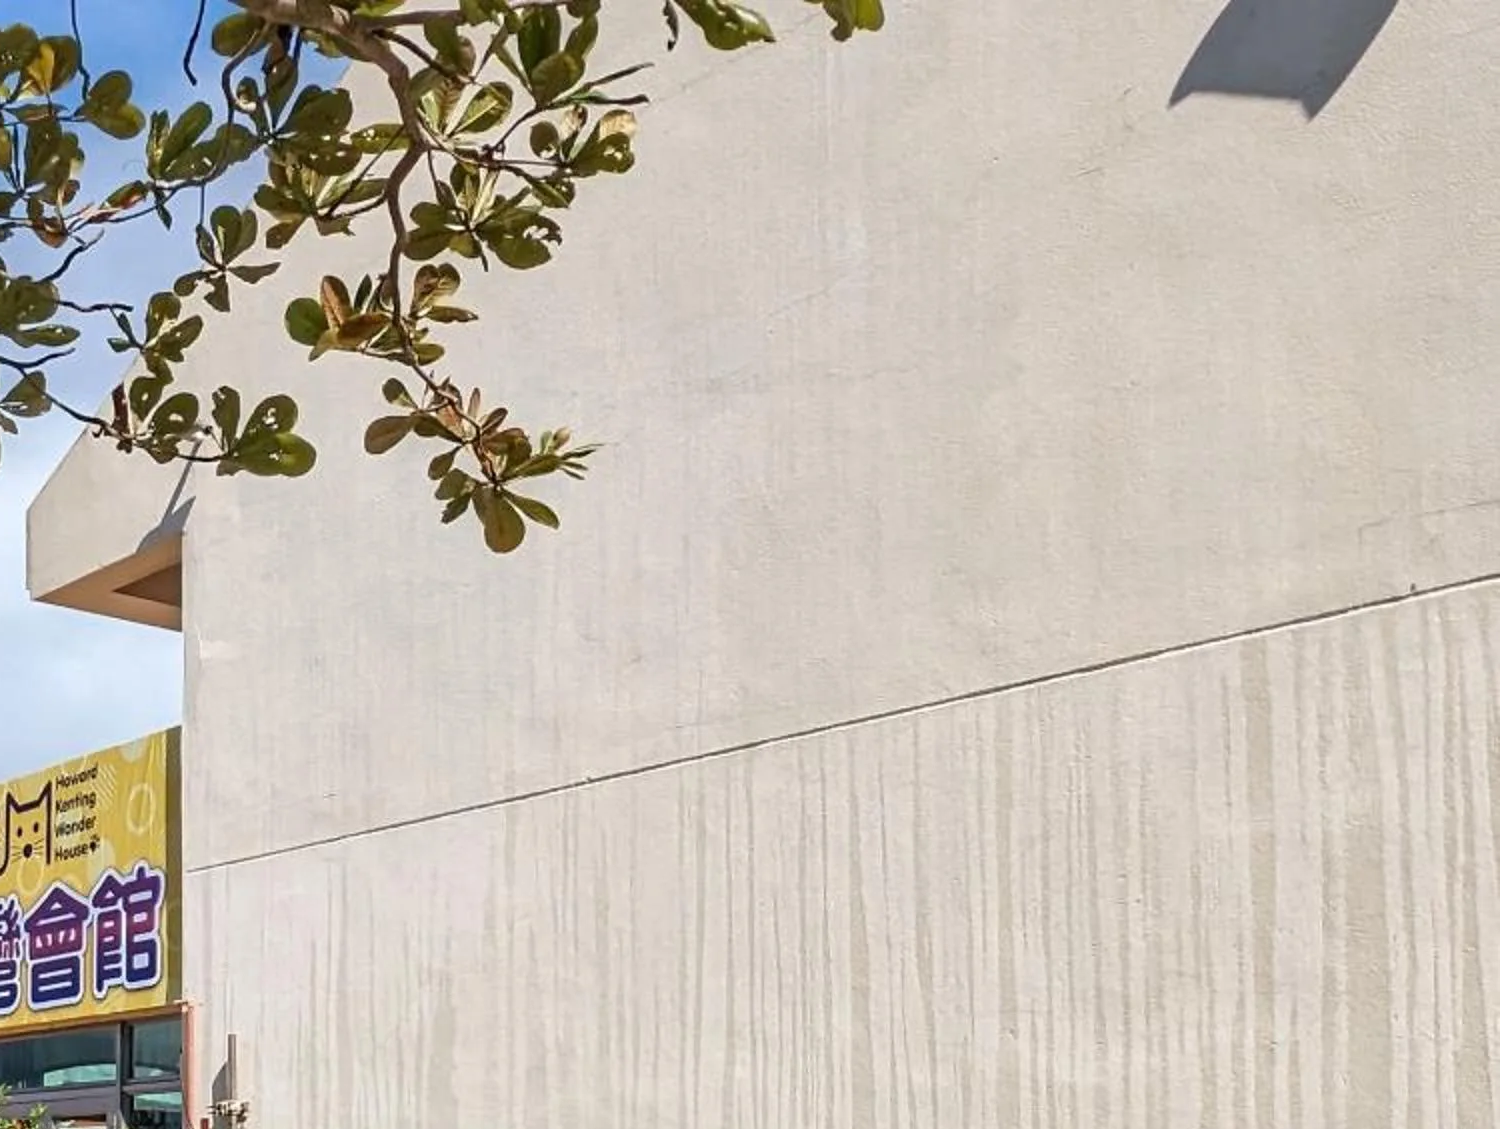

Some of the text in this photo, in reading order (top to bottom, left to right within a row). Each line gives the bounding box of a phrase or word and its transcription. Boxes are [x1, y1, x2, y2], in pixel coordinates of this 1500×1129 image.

[56, 763, 98, 790] Howard
[55, 815, 97, 838] Wonder
[55, 844, 89, 861] House
